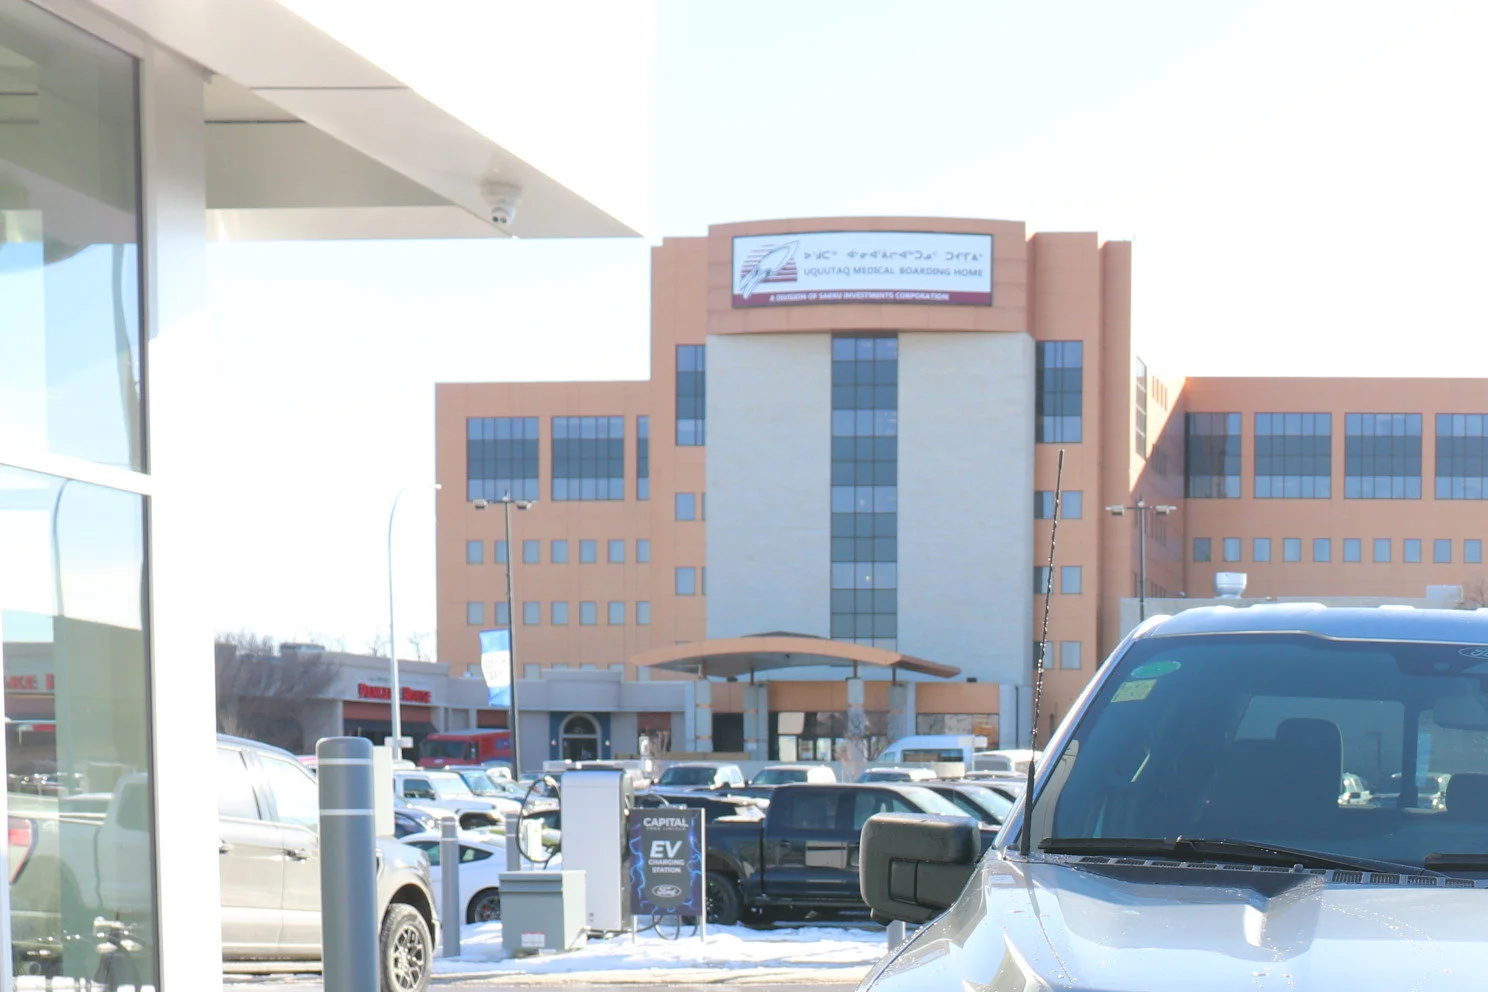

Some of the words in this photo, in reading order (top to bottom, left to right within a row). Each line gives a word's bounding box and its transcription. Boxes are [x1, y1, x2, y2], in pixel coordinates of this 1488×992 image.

[803, 266, 850, 277] UQUUTAQ
[852, 266, 895, 275] MEDICAL
[898, 266, 951, 276] BOARDING
[953, 268, 983, 277] HOME
[643, 818, 689, 827] CAPITAL
[650, 841, 682, 858] EV
